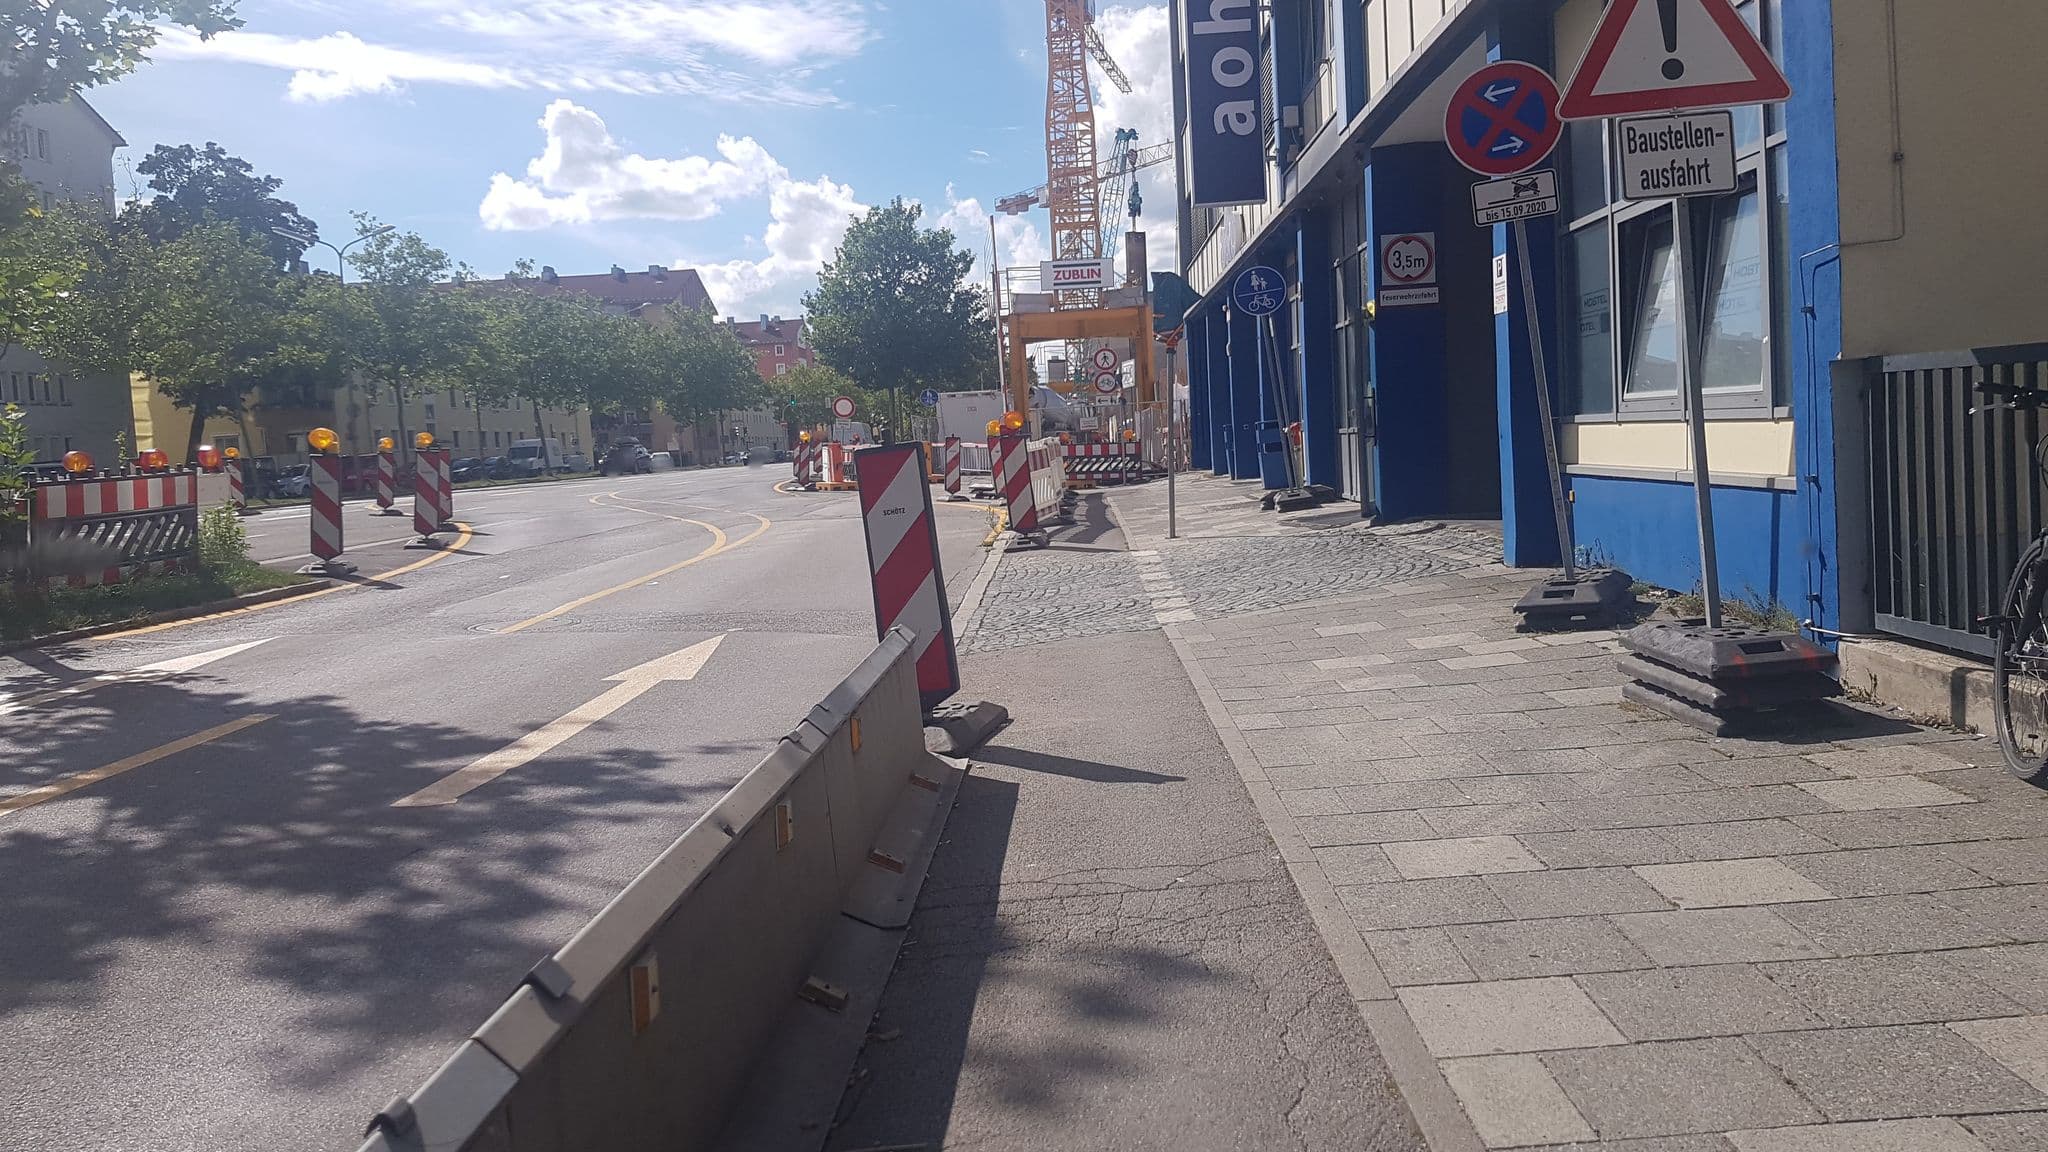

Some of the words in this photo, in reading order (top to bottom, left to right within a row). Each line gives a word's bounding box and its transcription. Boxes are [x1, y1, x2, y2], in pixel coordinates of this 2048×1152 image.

[1626, 121, 1725, 154] Baustellen-
[1640, 157, 1711, 190] ausfahrt
[1486, 210, 1499, 221] bis
[1501, 201, 1547, 218] 15.09.2020
[1053, 268, 1102, 281] ZÜBLIN
